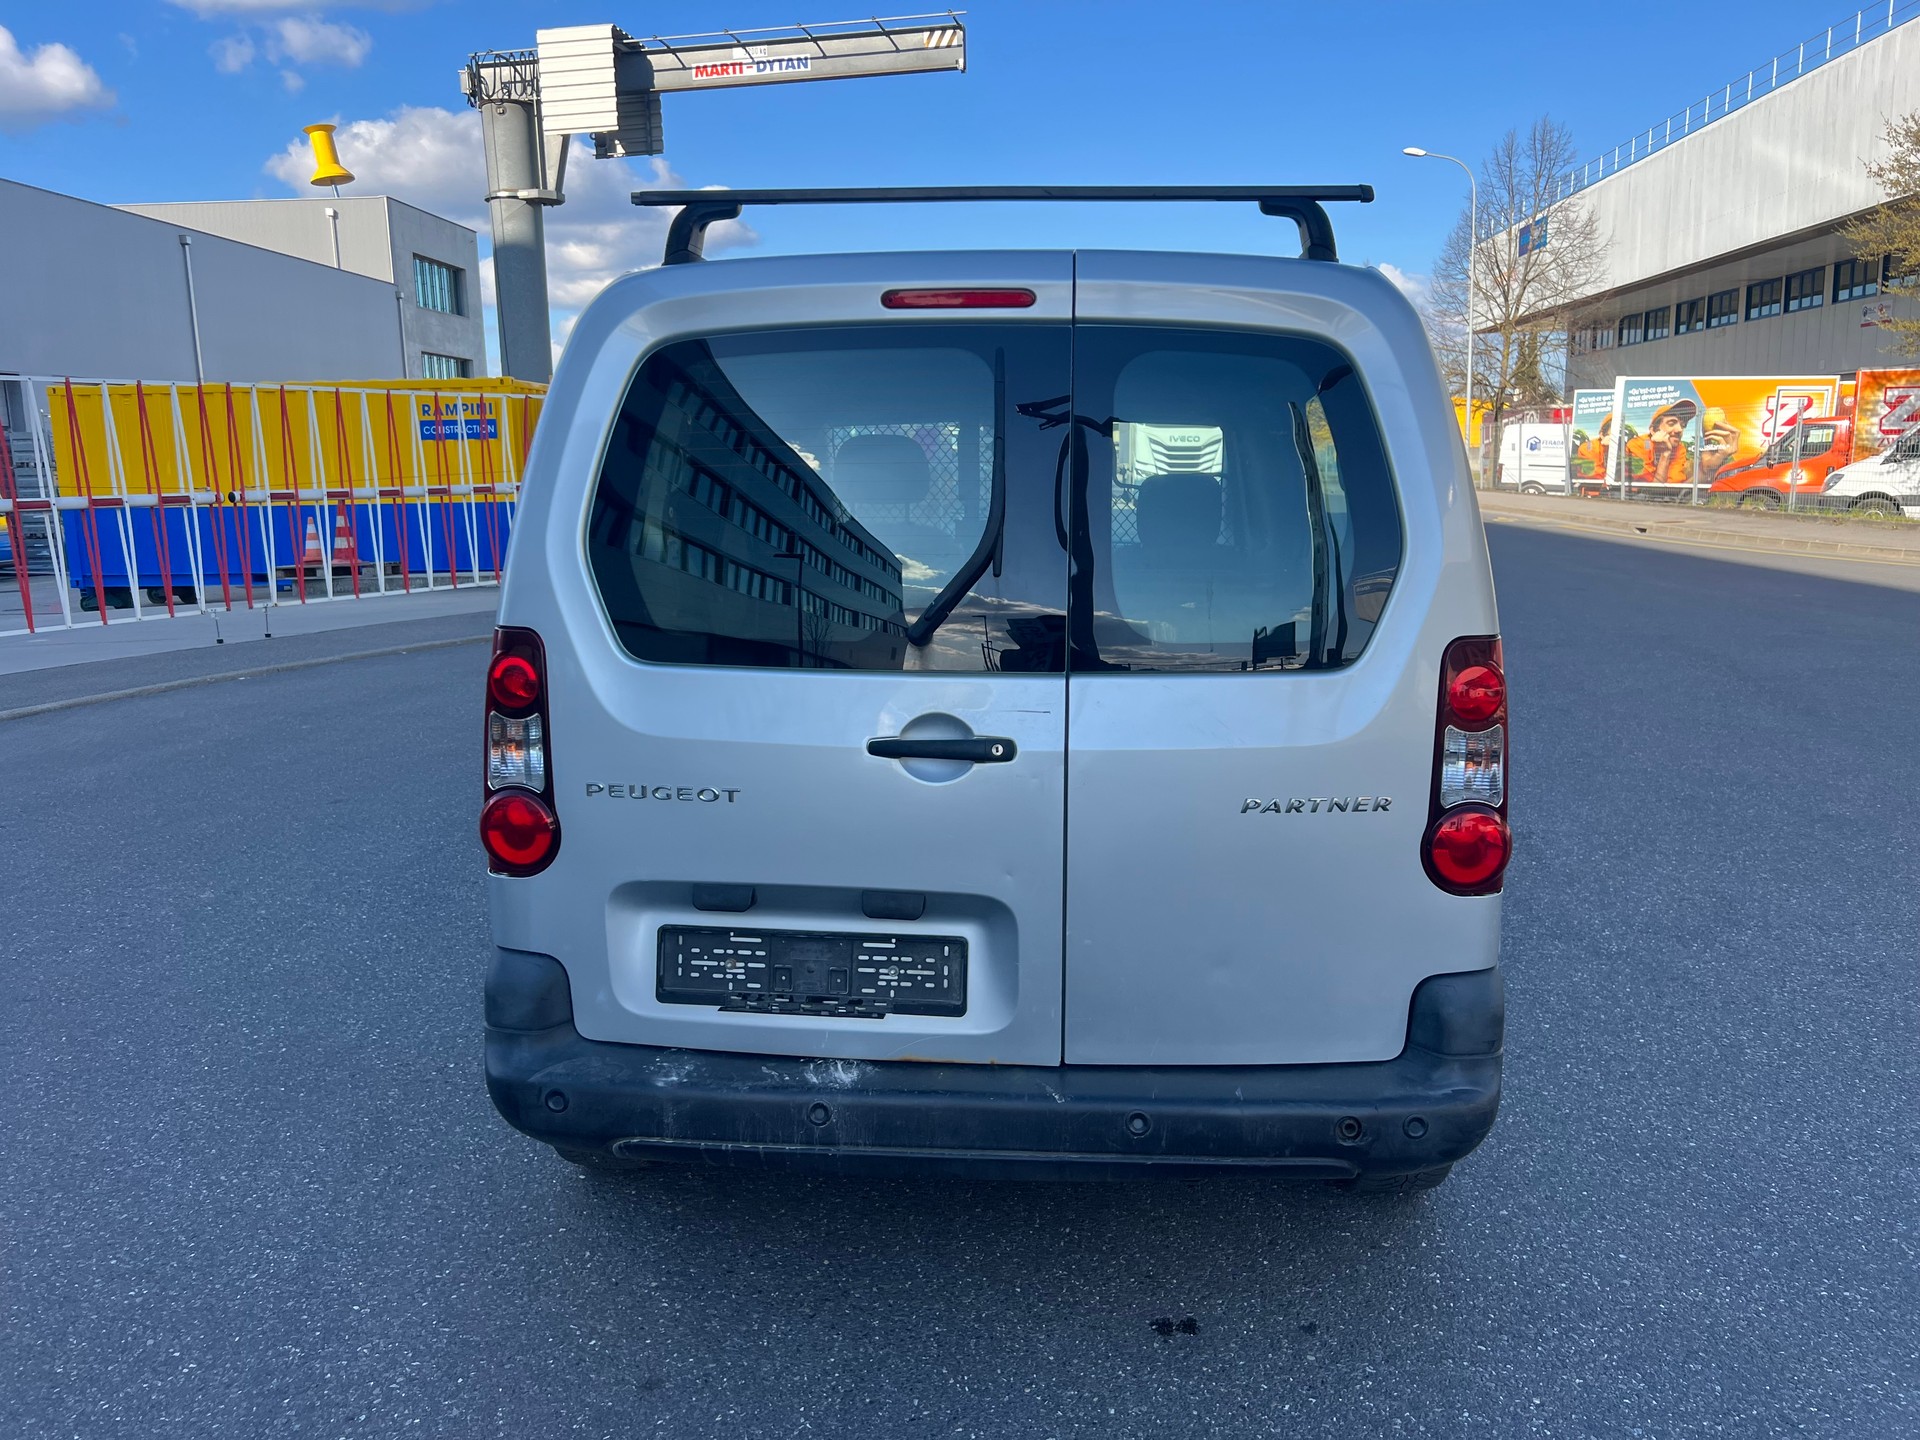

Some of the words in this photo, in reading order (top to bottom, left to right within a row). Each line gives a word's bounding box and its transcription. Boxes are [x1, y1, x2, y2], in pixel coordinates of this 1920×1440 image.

[694, 62, 744, 78] MARTI
[756, 56, 809, 73] DYTAN
[585, 782, 742, 803] PEUGEOT
[1240, 795, 1393, 814] PARTNER
